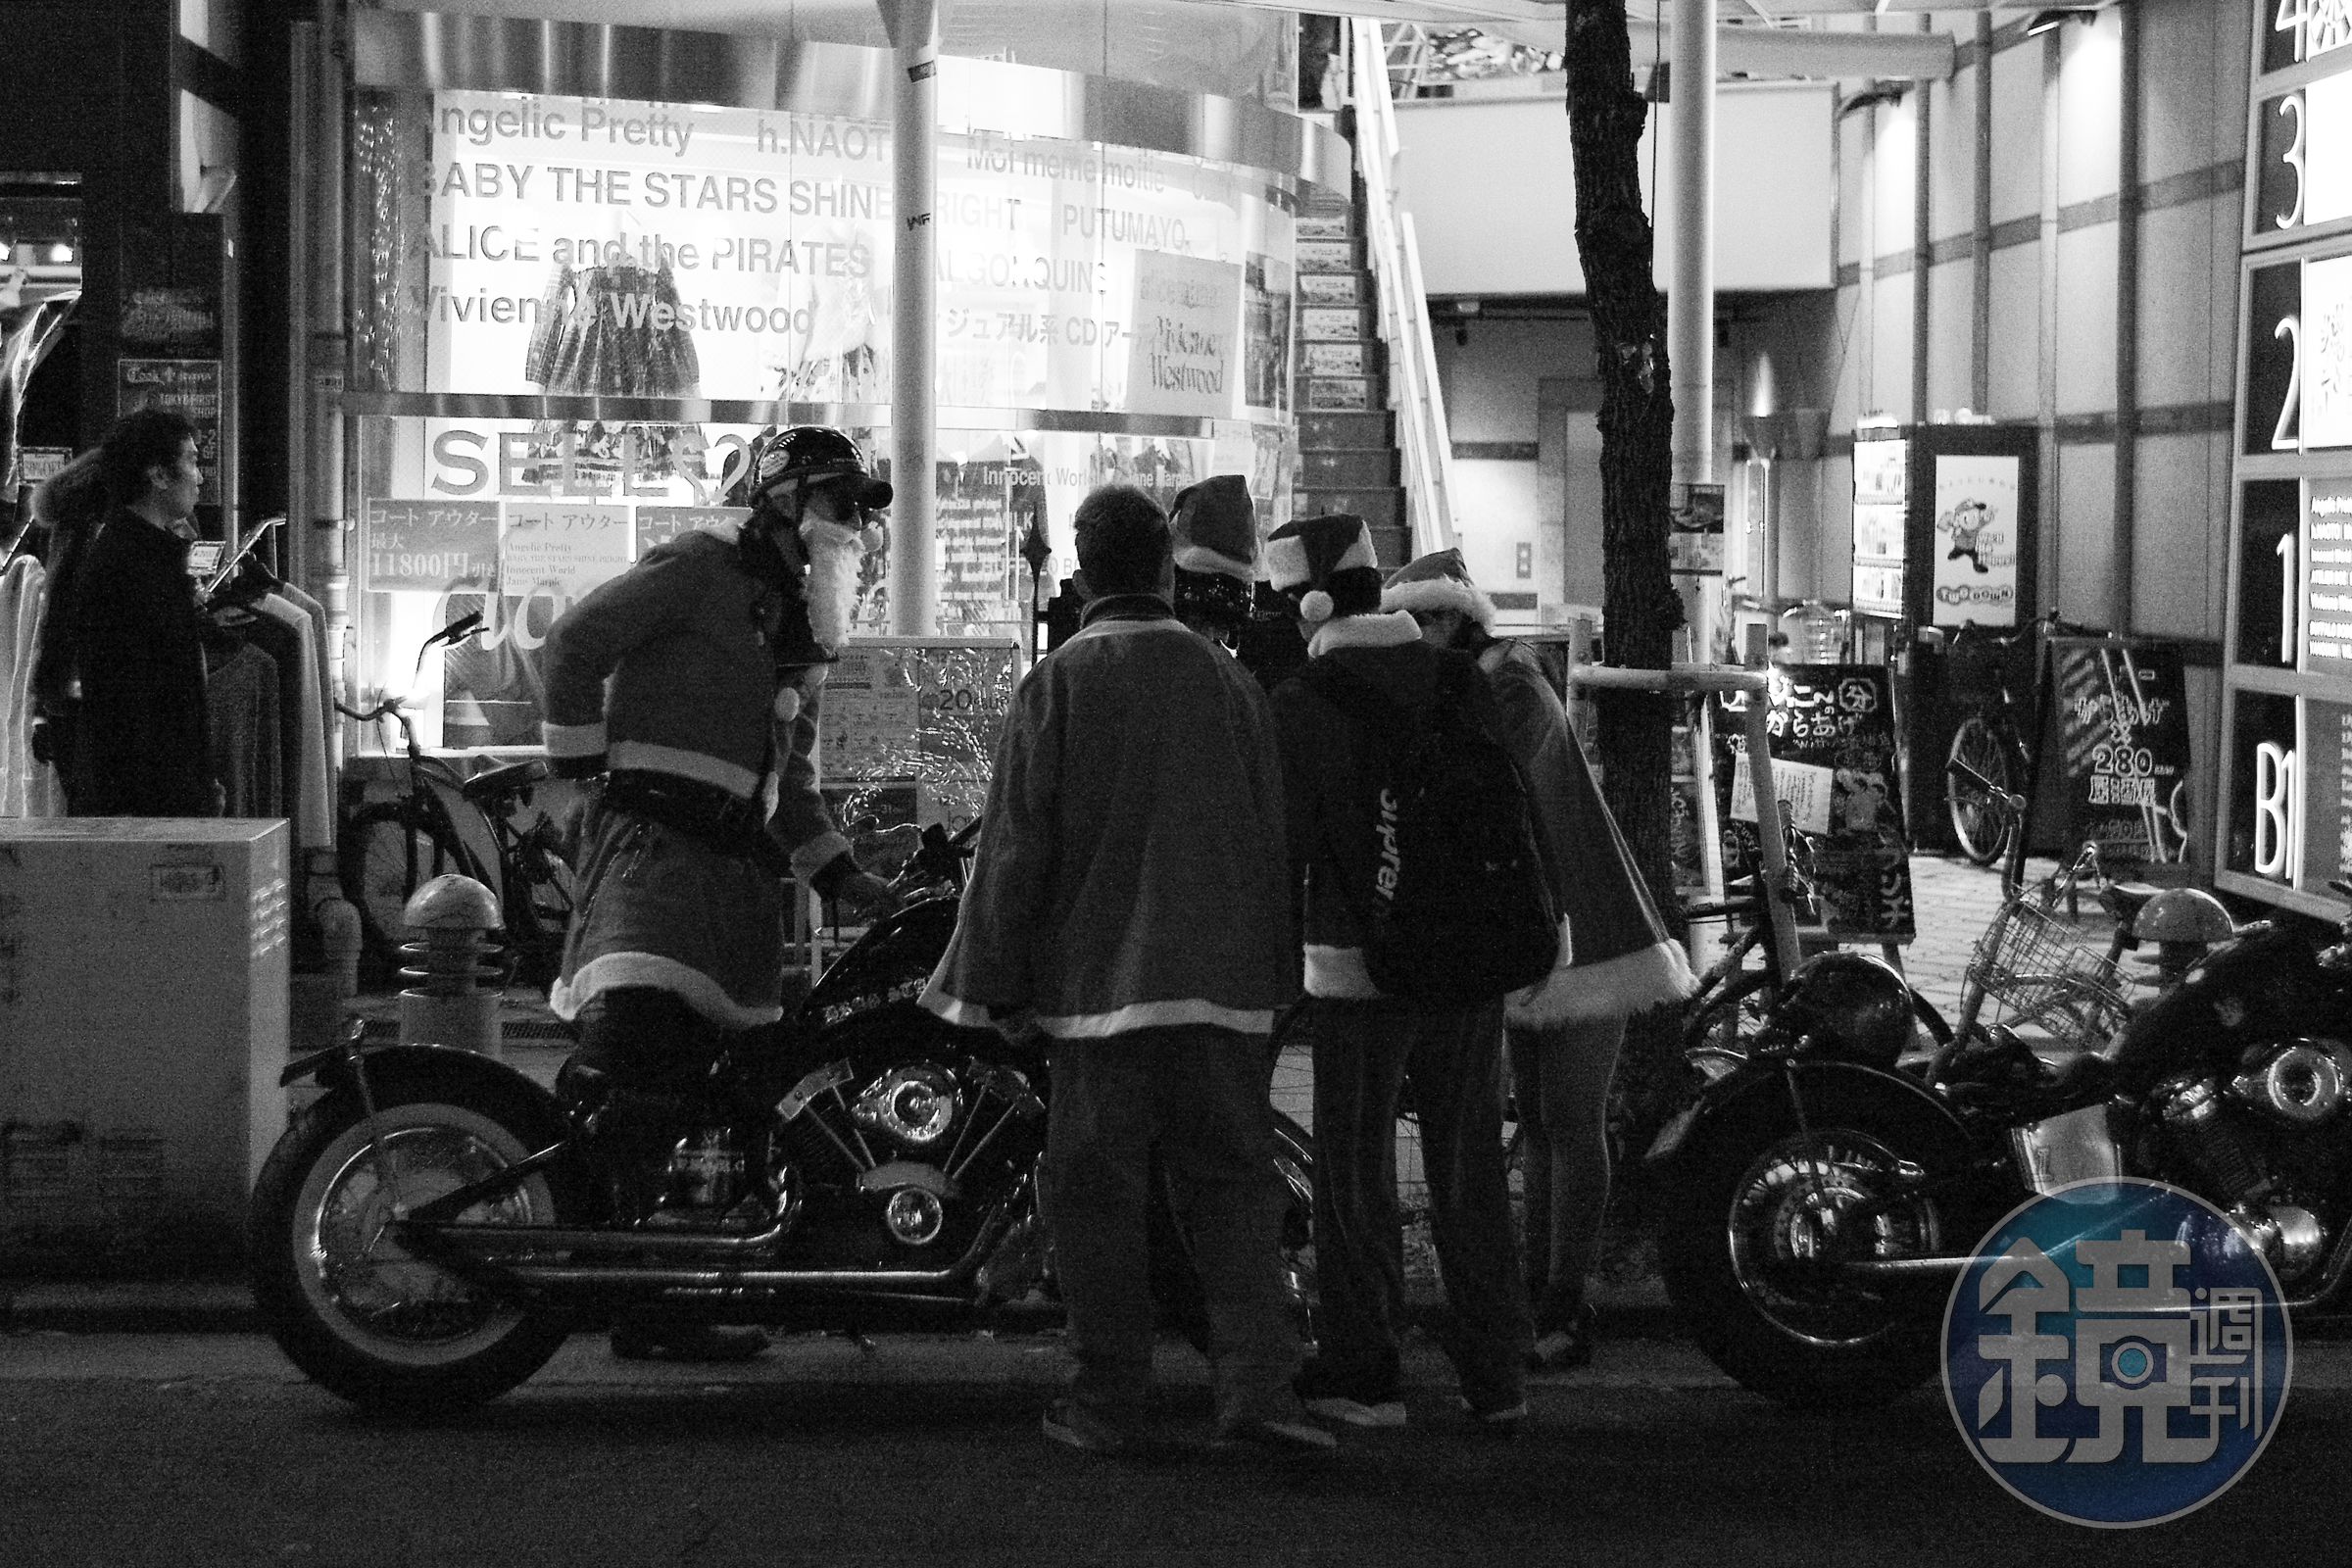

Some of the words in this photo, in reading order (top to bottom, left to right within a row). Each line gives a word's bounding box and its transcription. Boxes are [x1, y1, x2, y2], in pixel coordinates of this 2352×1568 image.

[433, 96, 566, 146] ngelic
[582, 99, 694, 156] Pretty
[758, 119, 890, 163] h.NAOT
[2276, 95, 2303, 229] 3
[547, 167, 631, 205] THE
[644, 172, 777, 214] STARS
[789, 179, 893, 220] SHINE
[937, 192, 1022, 230] RIGHT
[553, 231, 627, 265] and
[639, 234, 699, 270] the
[713, 236, 871, 278] PIRATES
[611, 292, 814, 333] Westwood
[2272, 317, 2299, 450] 2
[369, 508, 419, 527] コート
[427, 509, 498, 527] アウター
[509, 512, 554, 531] コート
[563, 512, 628, 531] アウター
[638, 514, 681, 533] コート
[2276, 532, 2294, 663] 1
[2092, 743, 2153, 777] 280
[2255, 742, 2295, 879] B1
